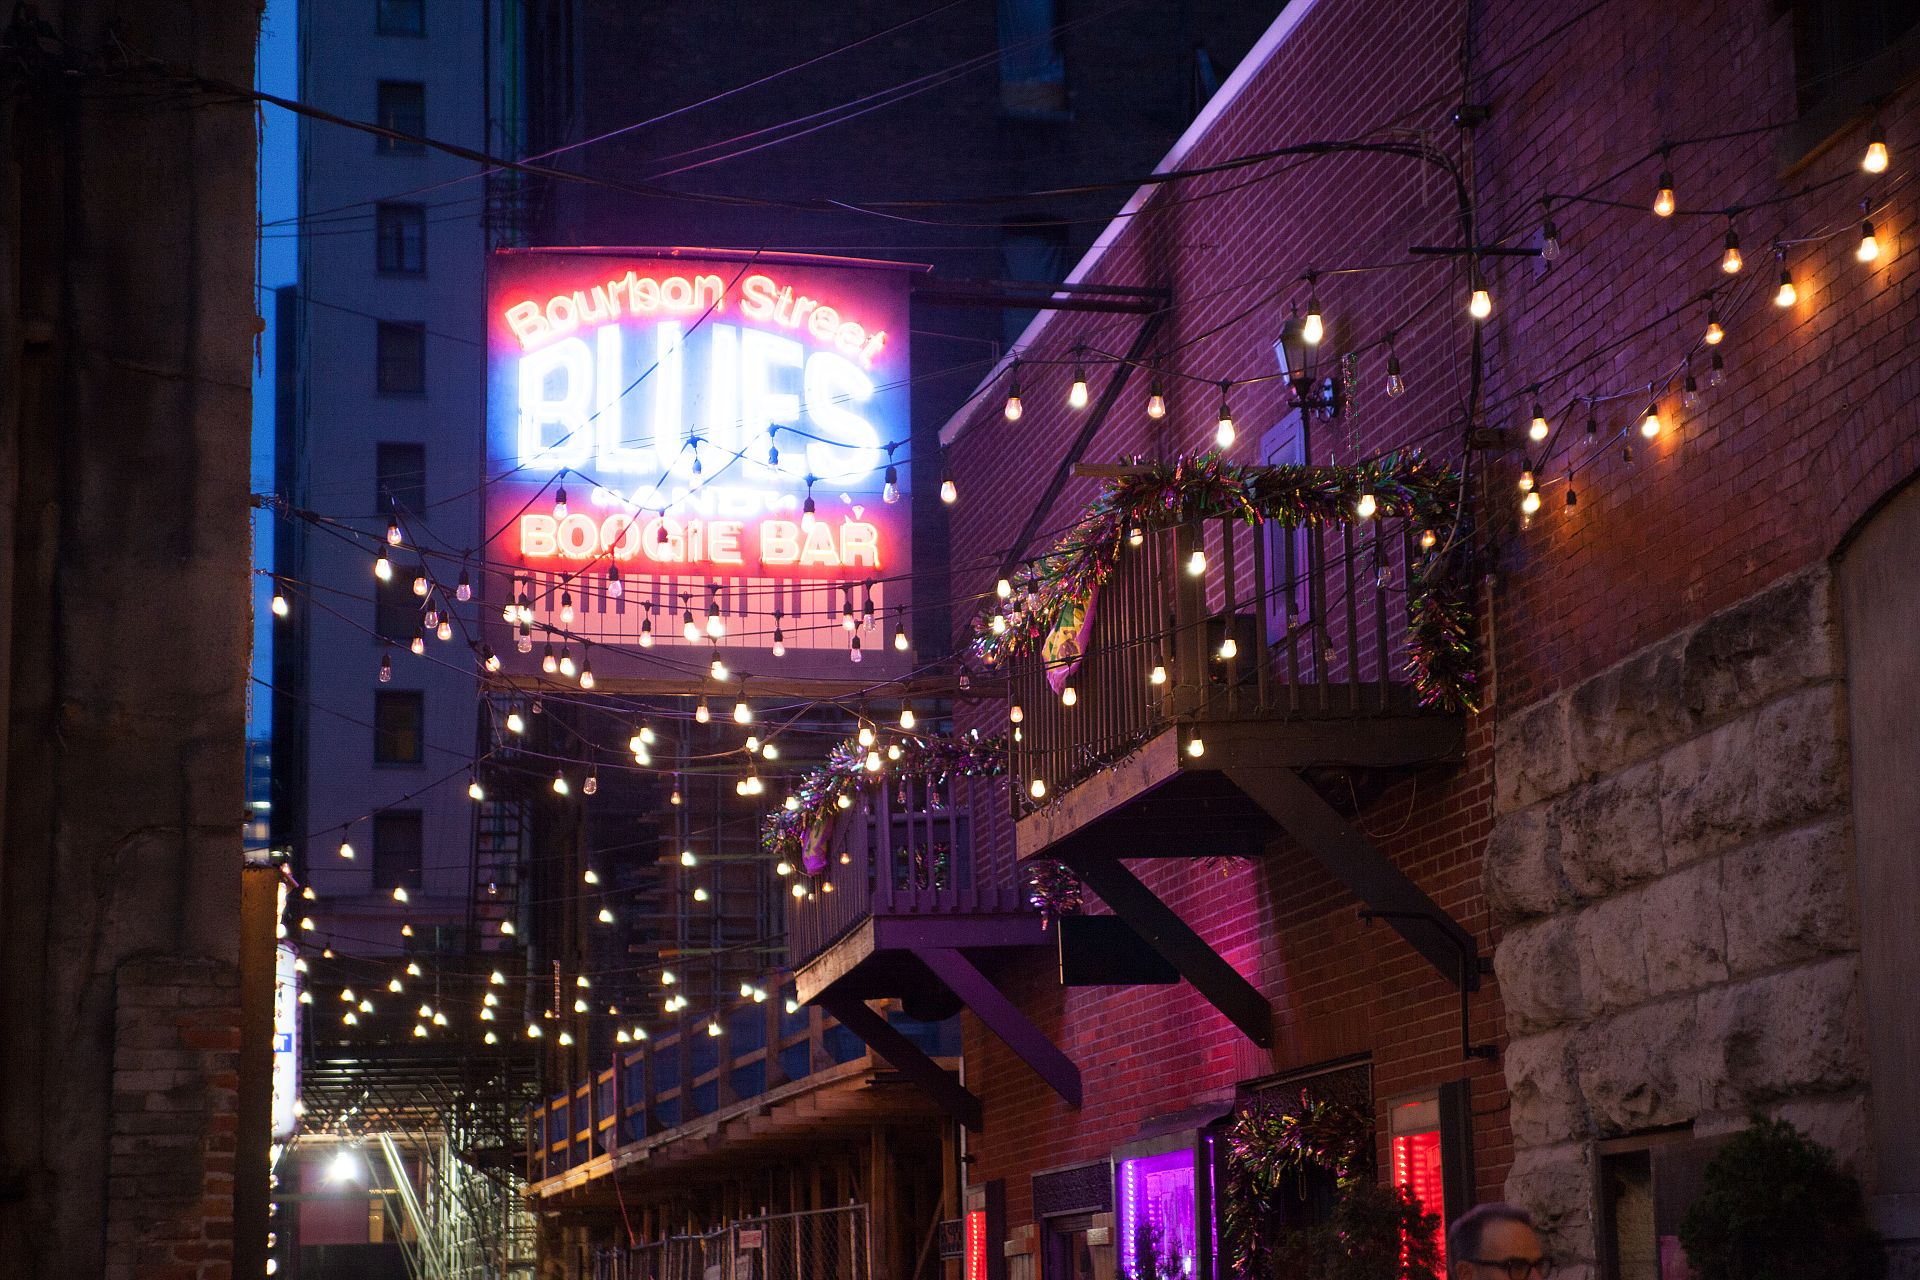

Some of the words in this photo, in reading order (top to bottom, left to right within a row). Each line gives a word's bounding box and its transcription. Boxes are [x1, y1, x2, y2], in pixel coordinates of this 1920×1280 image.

[505, 271, 724, 352] Bourbon
[740, 275, 887, 368] Street
[518, 320, 881, 485] BLUES
[521, 513, 743, 564] BOOGIE
[760, 520, 881, 568] BAR
